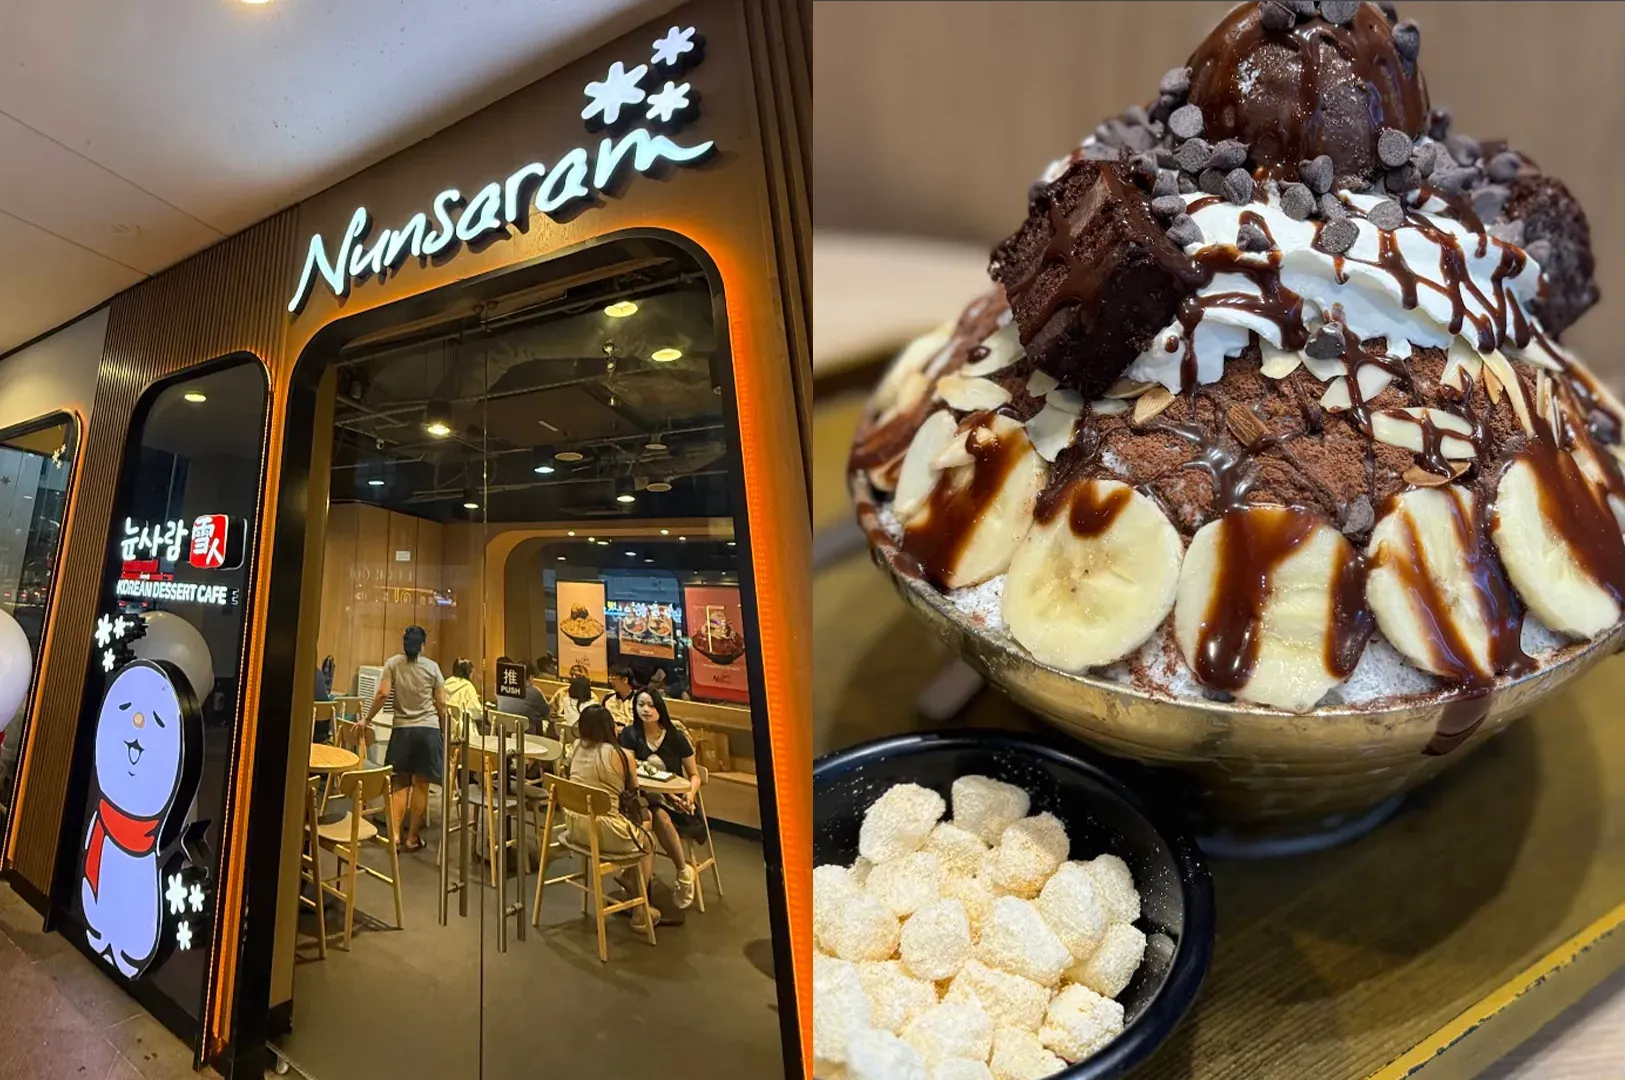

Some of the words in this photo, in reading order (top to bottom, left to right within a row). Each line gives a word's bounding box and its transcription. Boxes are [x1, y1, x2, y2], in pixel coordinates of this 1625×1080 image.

[287, 127, 714, 312] Nunsaram
[192, 515, 225, 565] 雪人
[116, 579, 152, 598] KOREAN
[152, 581, 198, 601] DESSERT
[197, 584, 228, 605] CAFE
[503, 668, 518, 685] 推
[500, 684, 521, 696] PUSH
